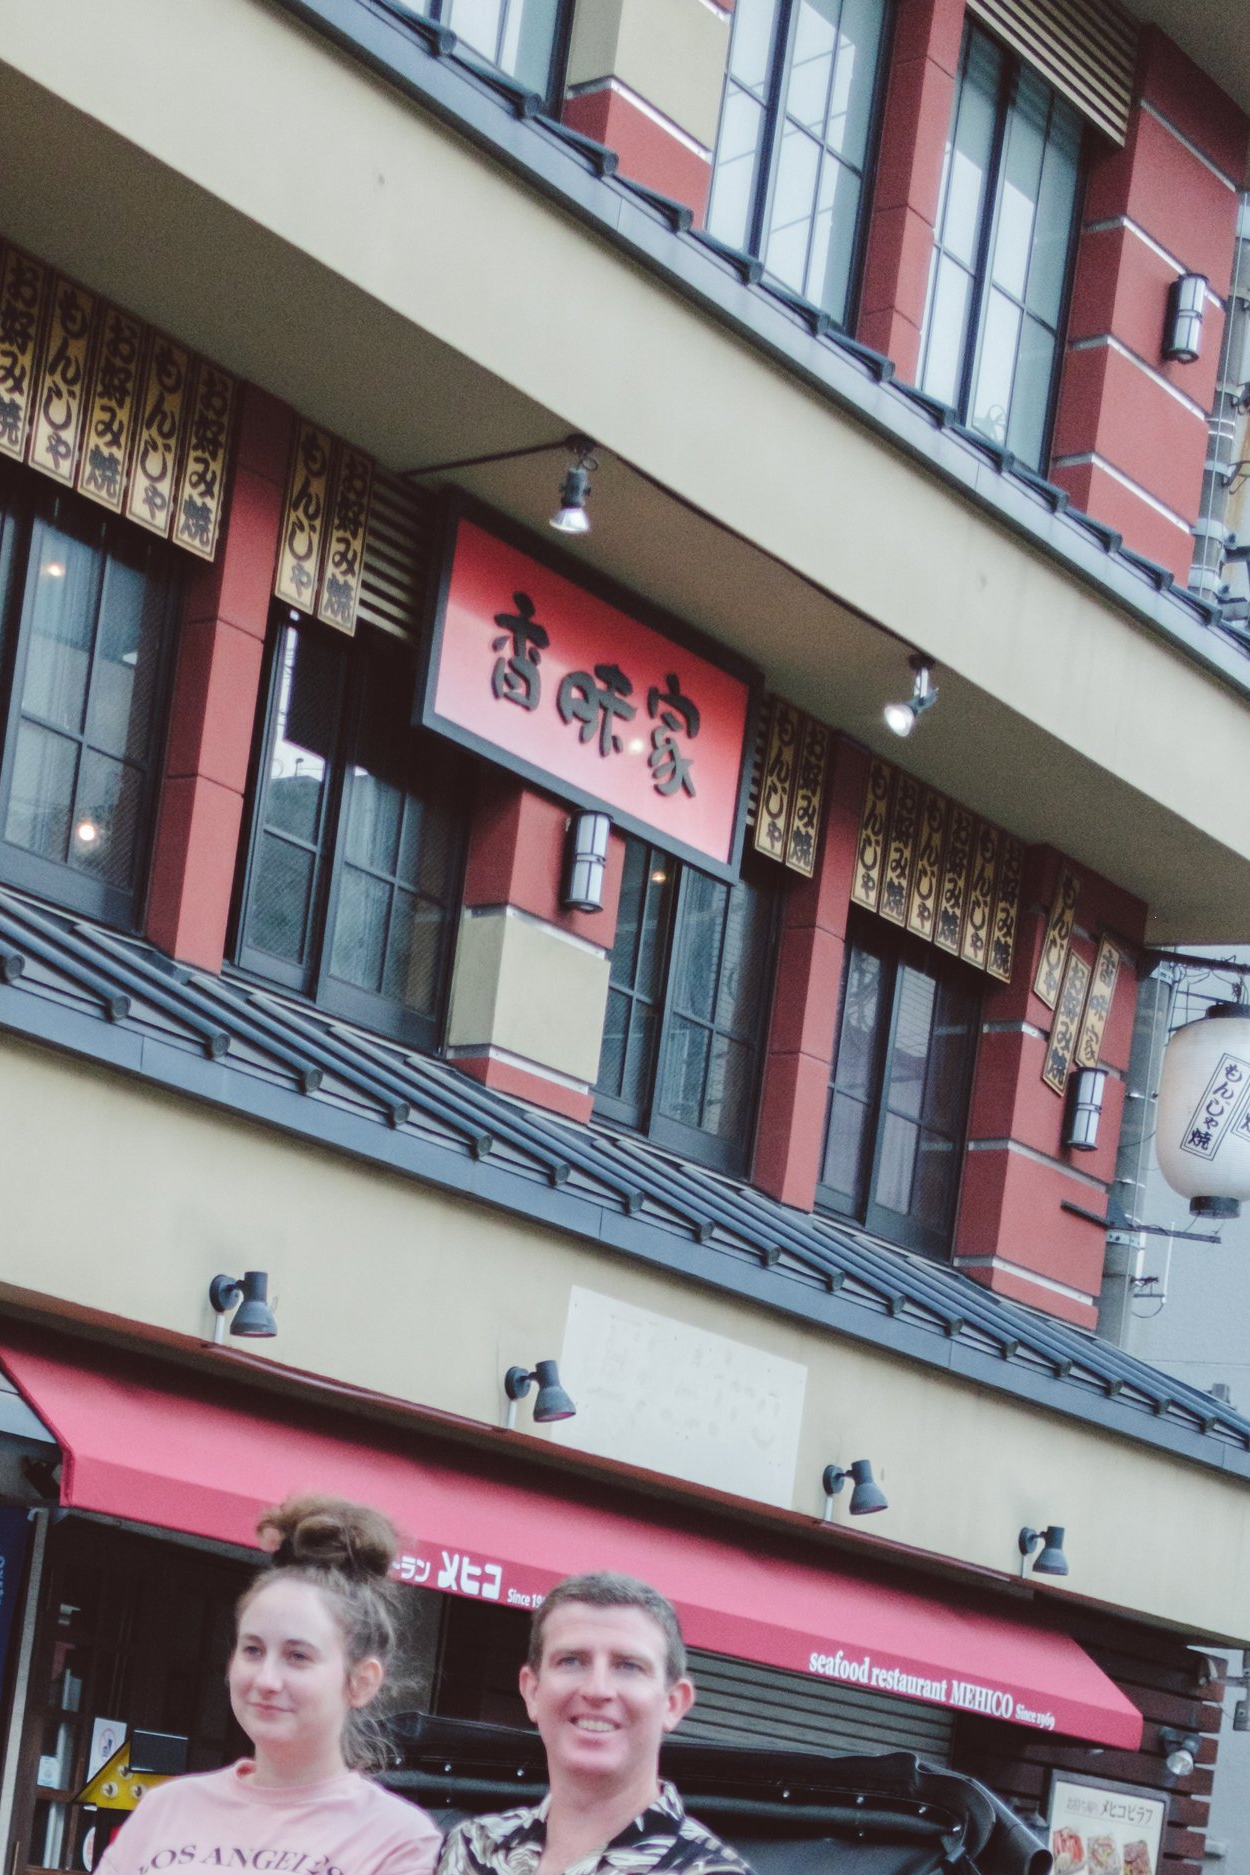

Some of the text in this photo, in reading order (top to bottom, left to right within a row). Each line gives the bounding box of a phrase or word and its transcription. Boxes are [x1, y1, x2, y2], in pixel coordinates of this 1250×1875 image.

[392, 1555, 431, 1582] ラン
[437, 1551, 503, 1601] メヒコ
[507, 1588, 531, 1607] Since
[808, 1649, 870, 1684] seafood
[870, 1665, 948, 1702] restaurant
[950, 1679, 1014, 1719] MEHICO
[1015, 1703, 1037, 1723] Since
